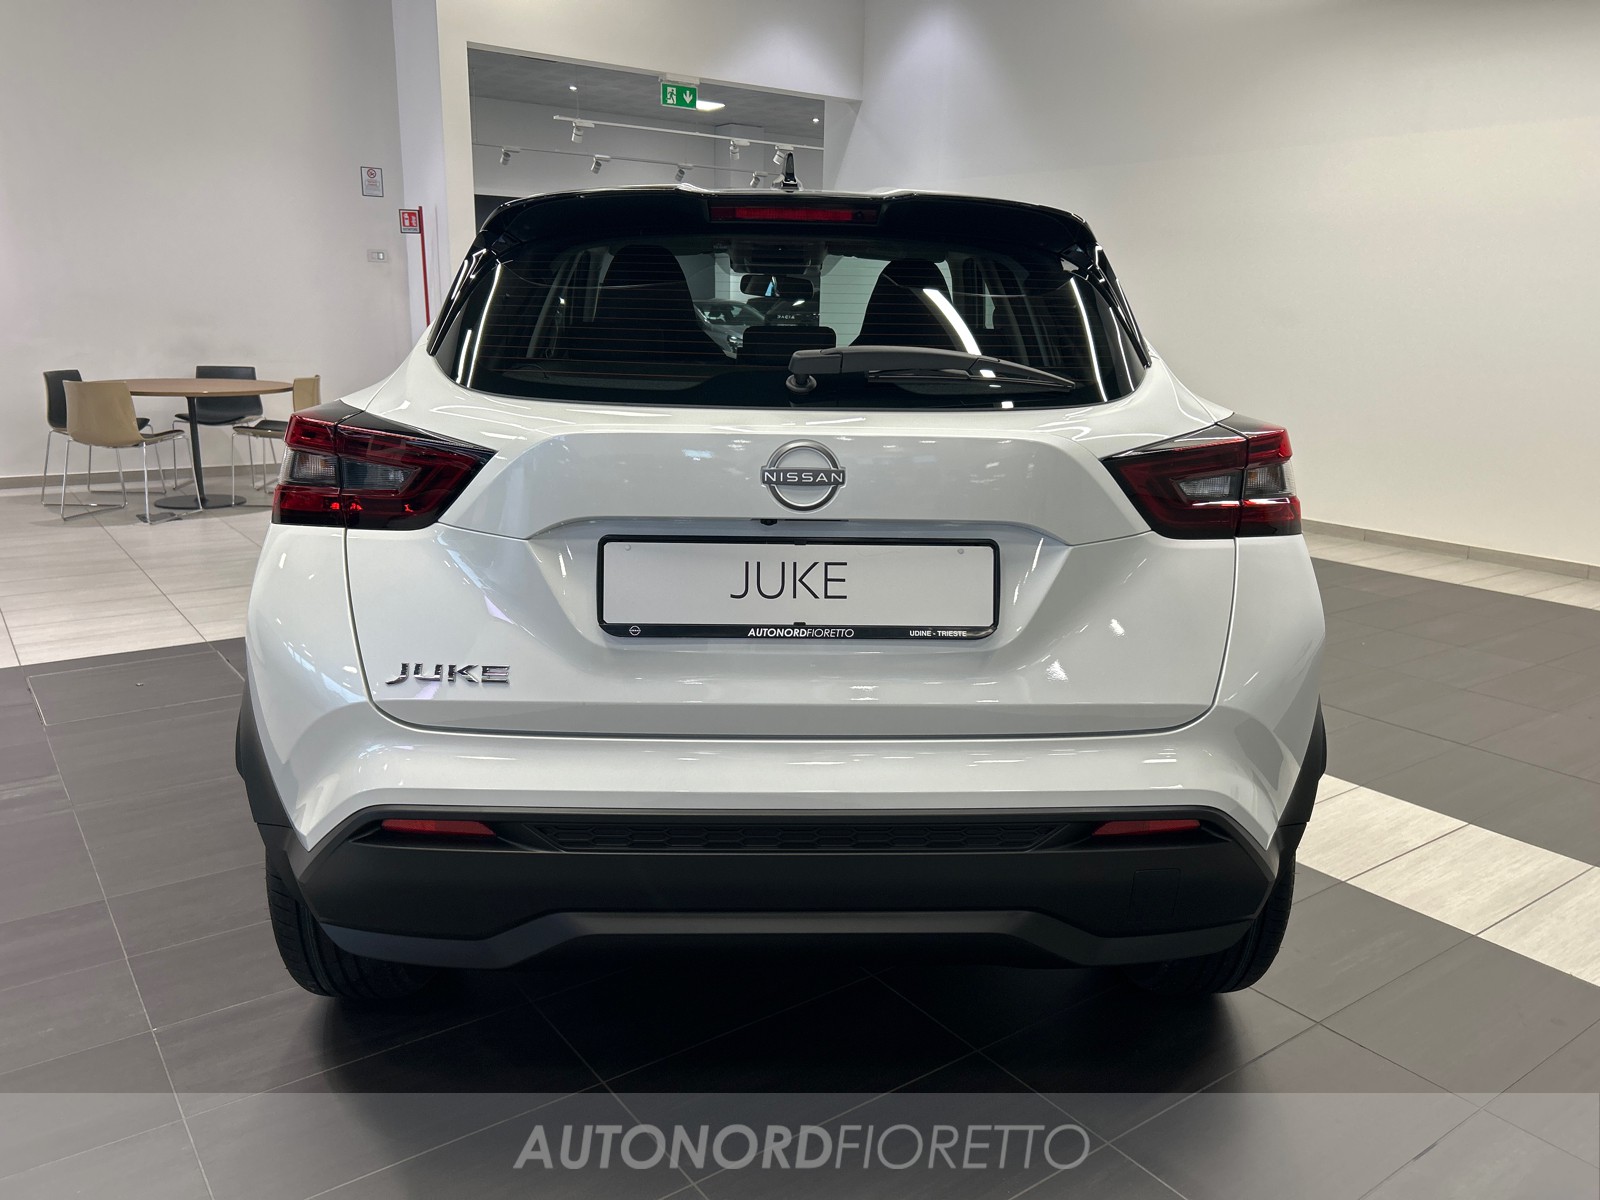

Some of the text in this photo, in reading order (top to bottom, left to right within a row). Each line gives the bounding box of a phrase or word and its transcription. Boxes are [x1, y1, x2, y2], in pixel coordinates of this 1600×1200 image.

[764, 471, 844, 483] NISSAN
[730, 561, 848, 600] JUKE
[748, 628, 855, 638] AUTONORDFIORETTO
[384, 662, 510, 684] JUKE
